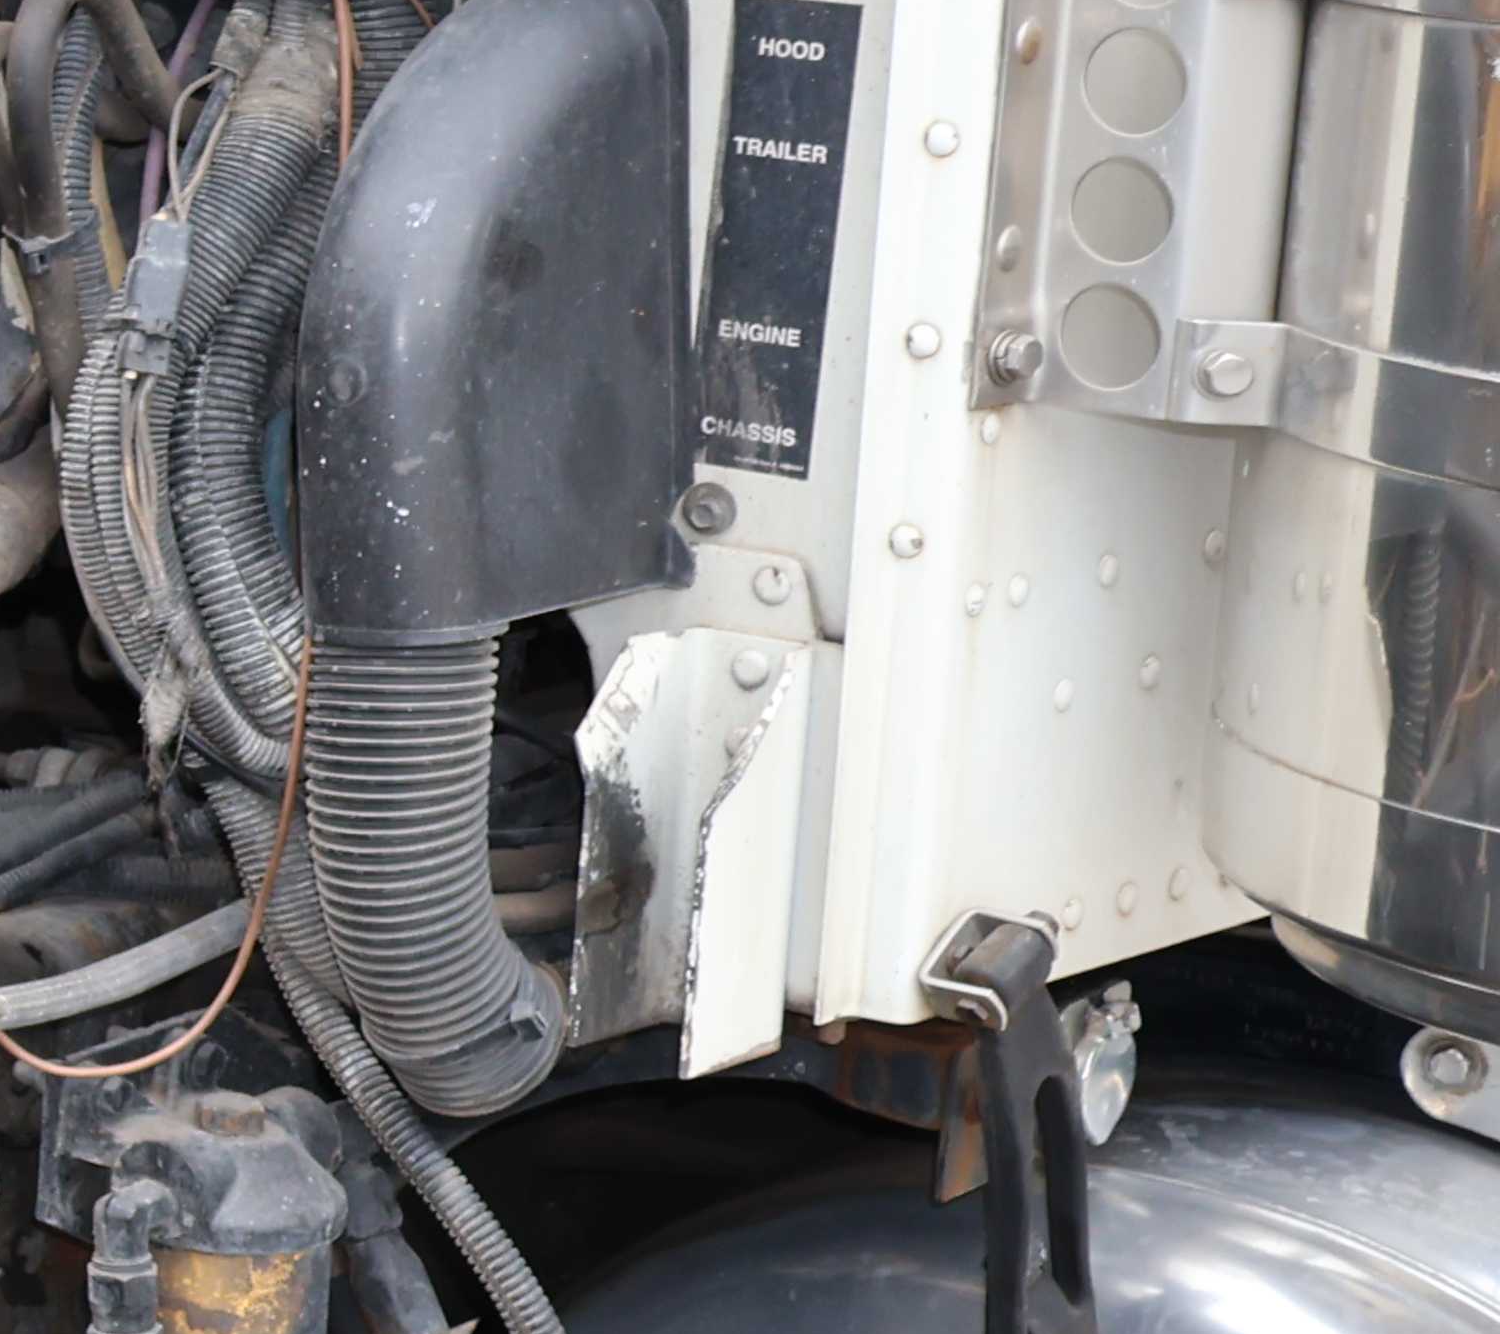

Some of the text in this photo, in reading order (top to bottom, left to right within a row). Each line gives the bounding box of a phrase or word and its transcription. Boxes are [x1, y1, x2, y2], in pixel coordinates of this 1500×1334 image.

[757, 37, 826, 62] HOOD
[732, 135, 828, 165] TRAILER
[717, 319, 801, 348] ENGINE
[699, 415, 797, 448] CHASSIS
